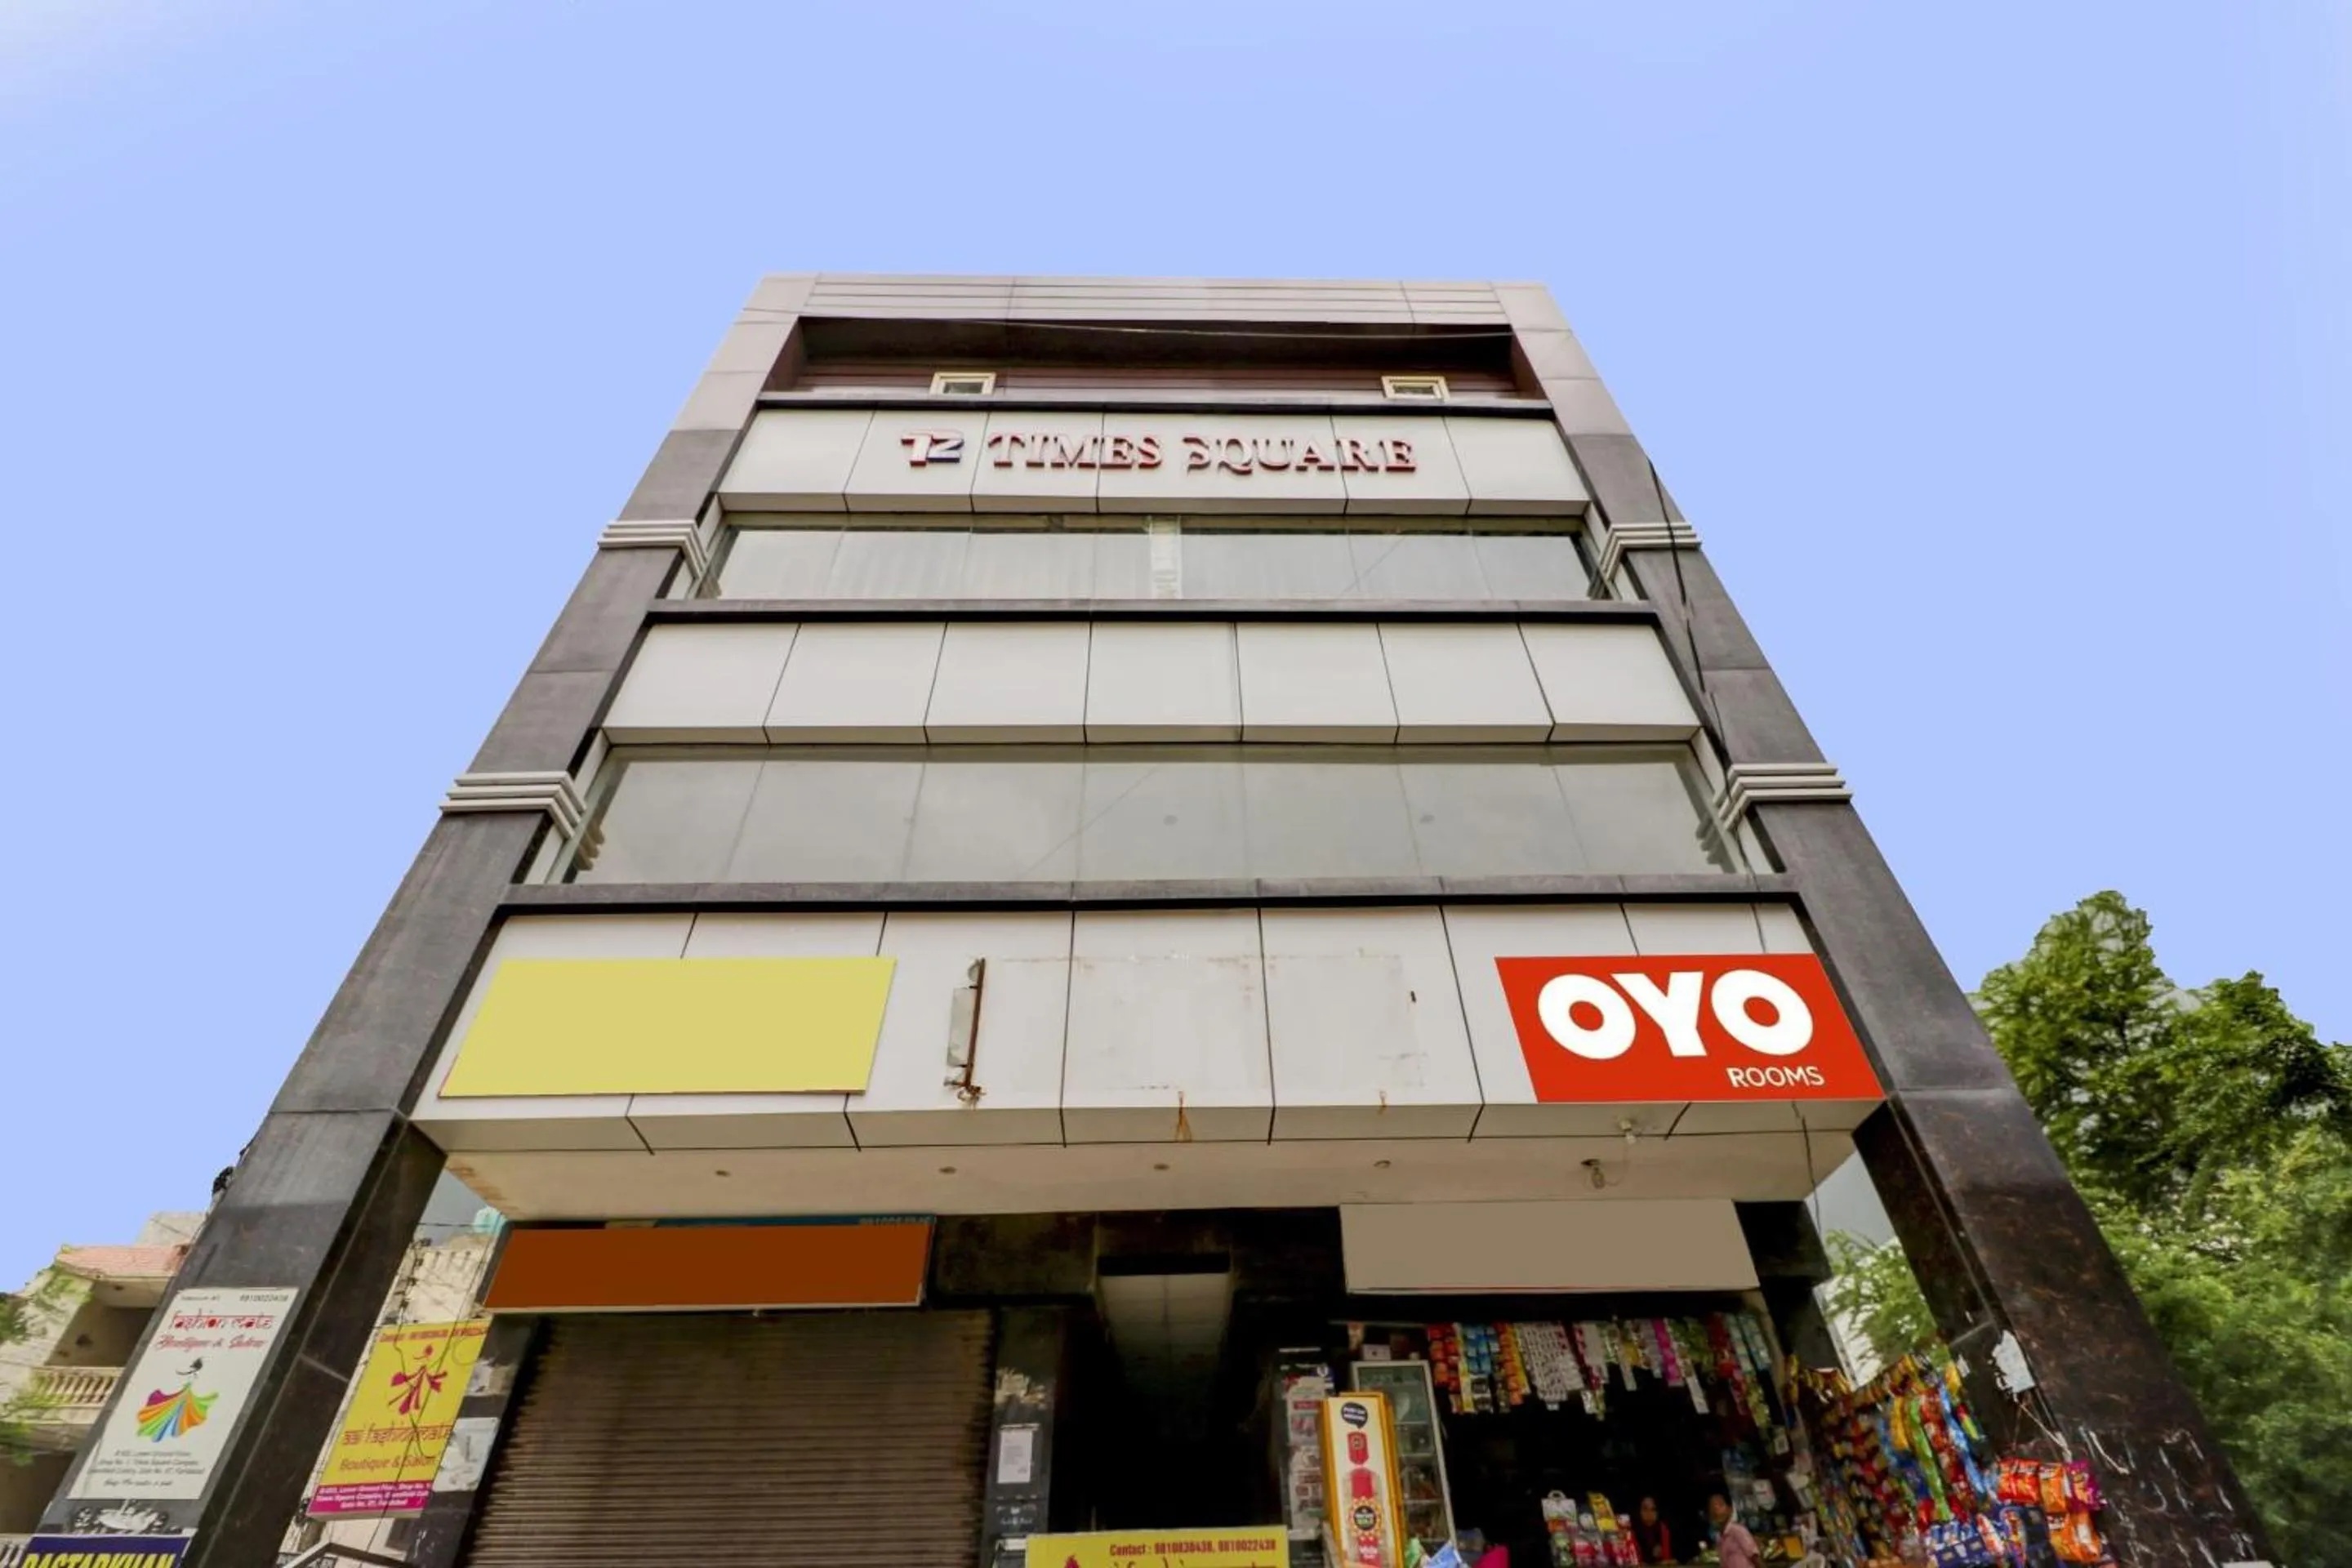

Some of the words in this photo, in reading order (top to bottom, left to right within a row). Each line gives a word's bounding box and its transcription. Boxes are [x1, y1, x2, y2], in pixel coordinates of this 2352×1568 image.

[987, 431, 1163, 470] TIMES
[1182, 434, 1416, 475] SQUARE
[1538, 969, 1813, 1060] OYO
[1726, 1065, 1825, 1088] ROOMS
[1110, 1544, 1146, 1556] Contact
